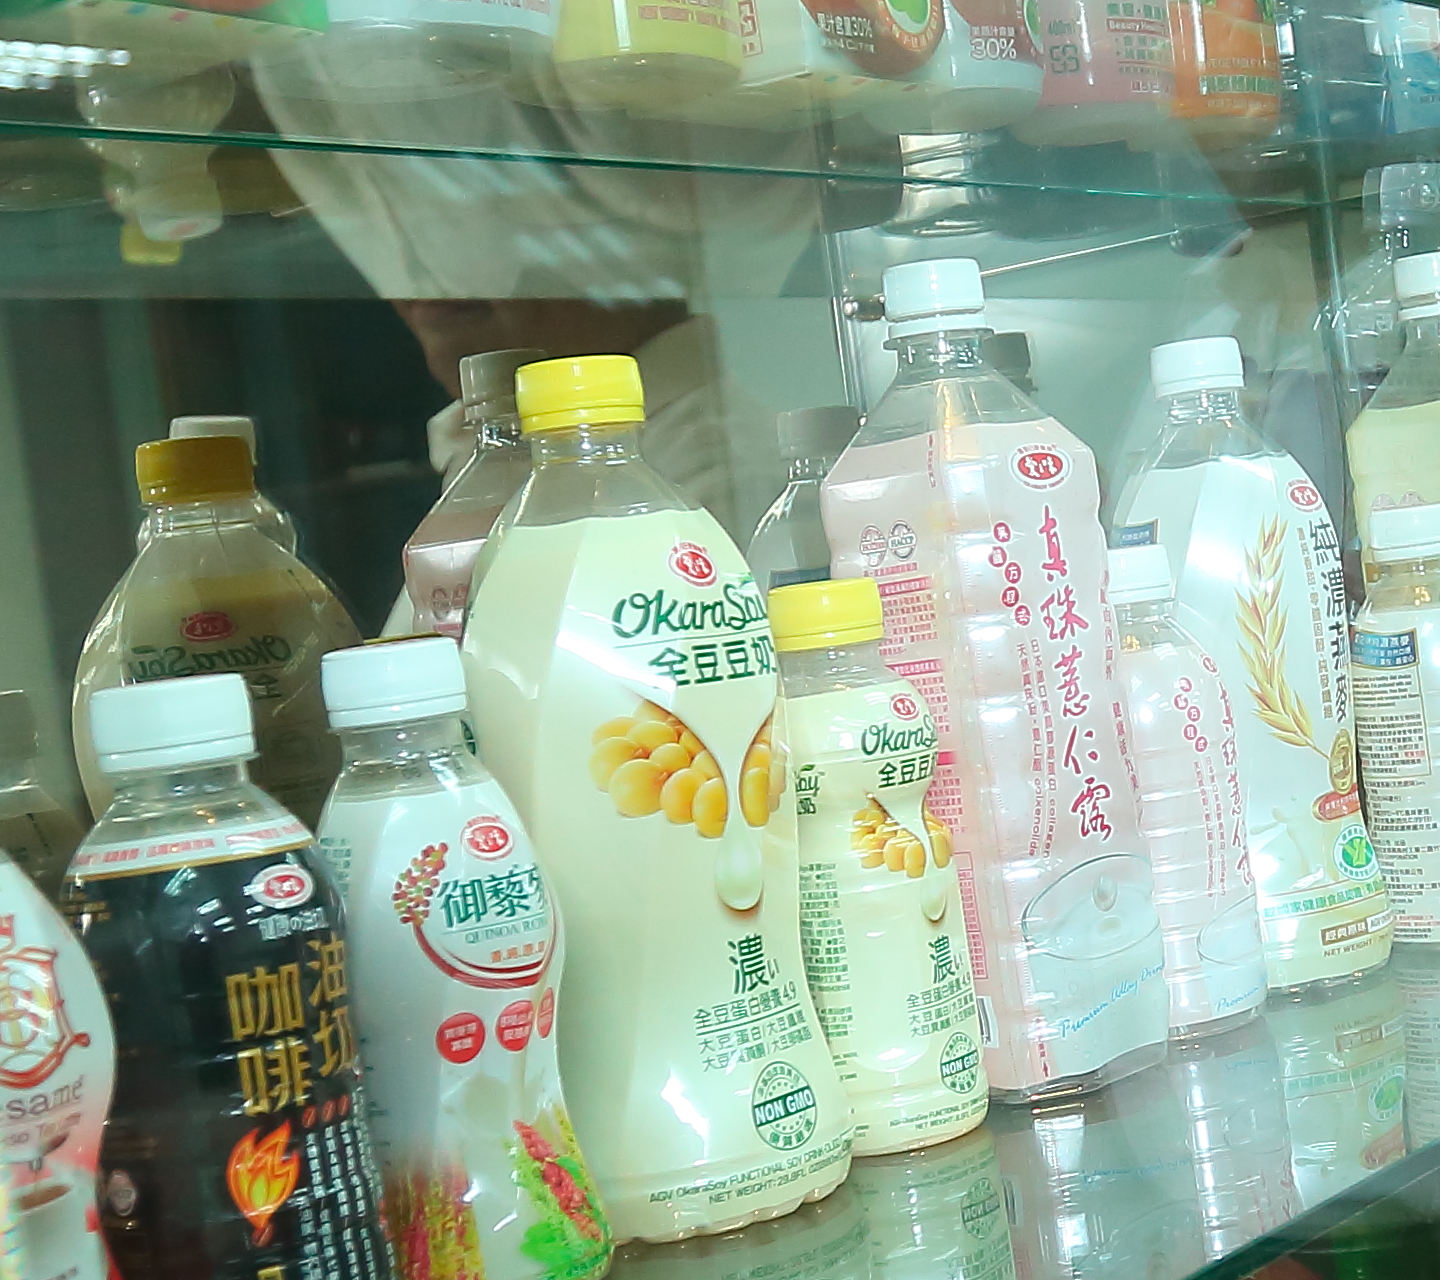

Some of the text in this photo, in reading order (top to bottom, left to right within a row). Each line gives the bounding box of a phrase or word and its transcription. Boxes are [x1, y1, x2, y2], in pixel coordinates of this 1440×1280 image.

[969, 37, 1017, 61] 30%
[648, 634, 779, 687] 全豆豆奶
[1038, 505, 1114, 842] 真珠薏仁露
[303, 931, 356, 1080] 油切
[224, 961, 314, 1118] 咖啡
[942, 1058, 963, 1076] NON
[754, 1088, 814, 1125] NON GMO
